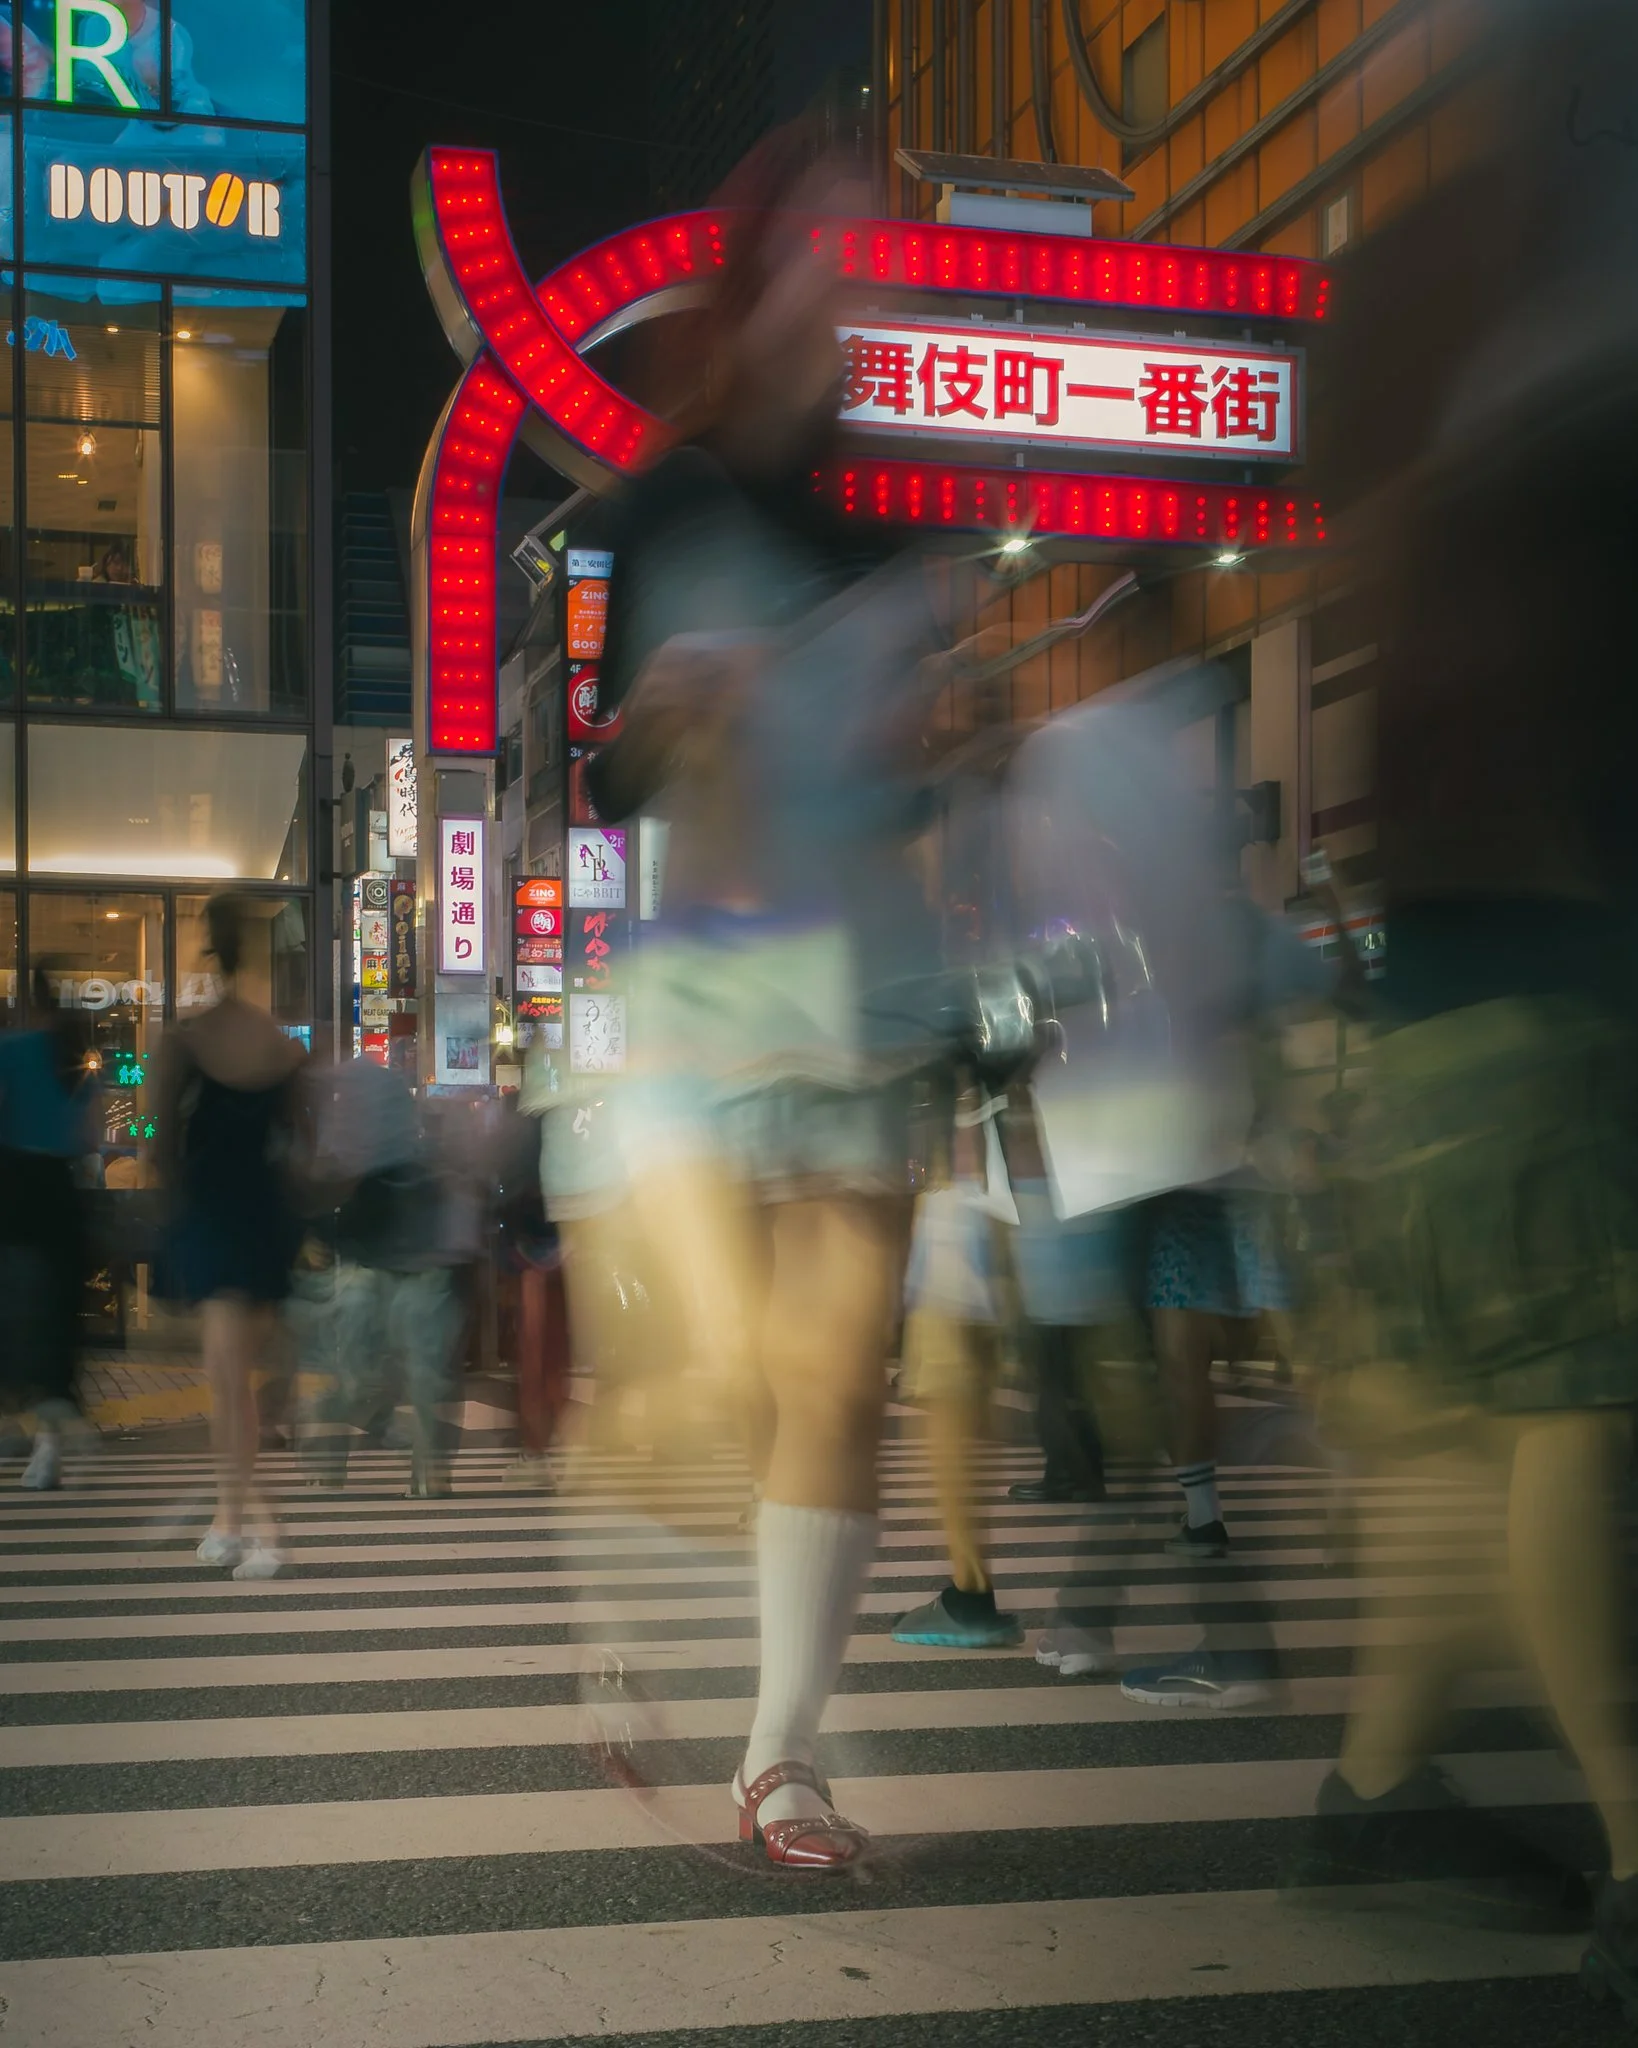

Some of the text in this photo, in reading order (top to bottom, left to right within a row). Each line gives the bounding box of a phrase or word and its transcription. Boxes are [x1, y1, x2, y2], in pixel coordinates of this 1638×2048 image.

[54, 0, 141, 109] R
[50, 164, 281, 237] DOUTOR
[842, 334, 1281, 442] 舞伎町一番街
[570, 664, 582, 674] 4F
[570, 747, 583, 758] 3F
[609, 835, 625, 848] 2F
[450, 831, 476, 960] 劇場通り
[528, 889, 556, 897] ZINO
